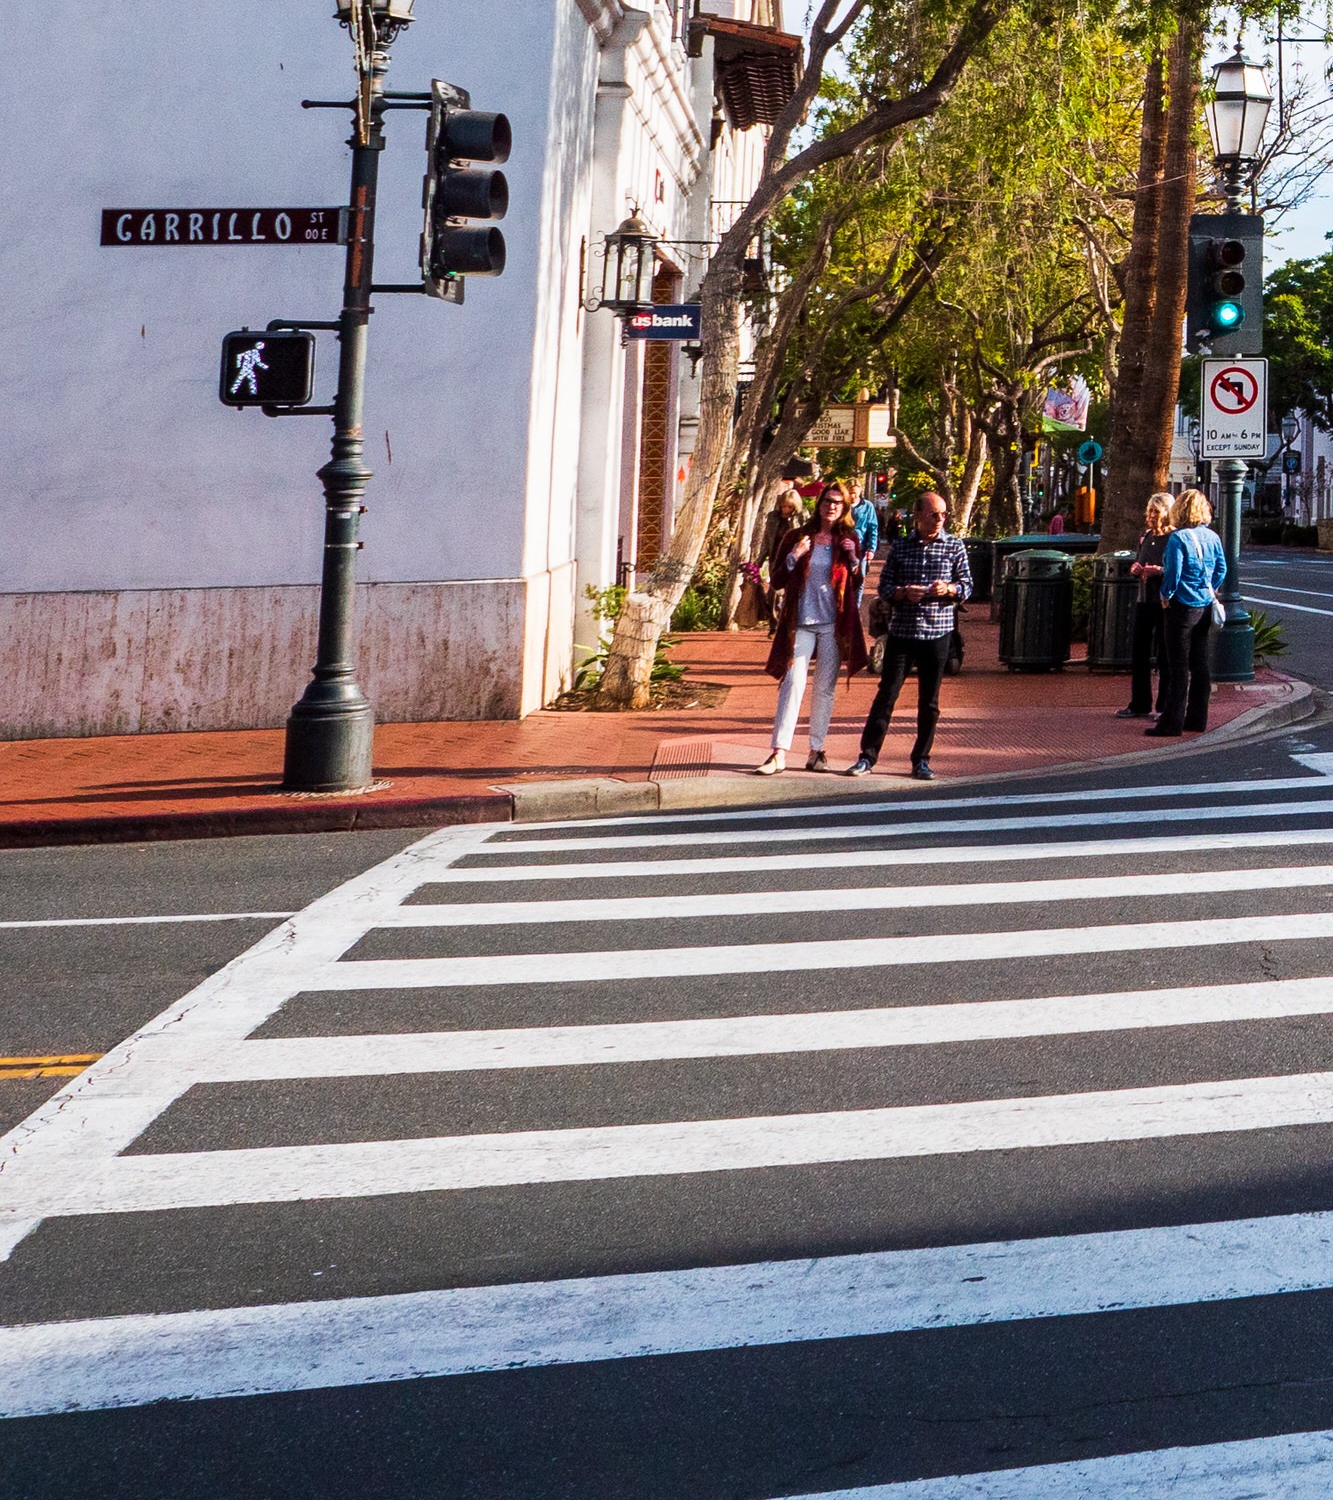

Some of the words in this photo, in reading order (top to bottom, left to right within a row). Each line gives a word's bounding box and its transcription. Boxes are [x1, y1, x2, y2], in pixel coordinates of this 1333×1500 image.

[310, 212, 324, 223] ST
[116, 212, 292, 241] CARRILLO
[322, 228, 328, 240] E
[1206, 430, 1218, 440] 10
[1241, 430, 1248, 440] 6
